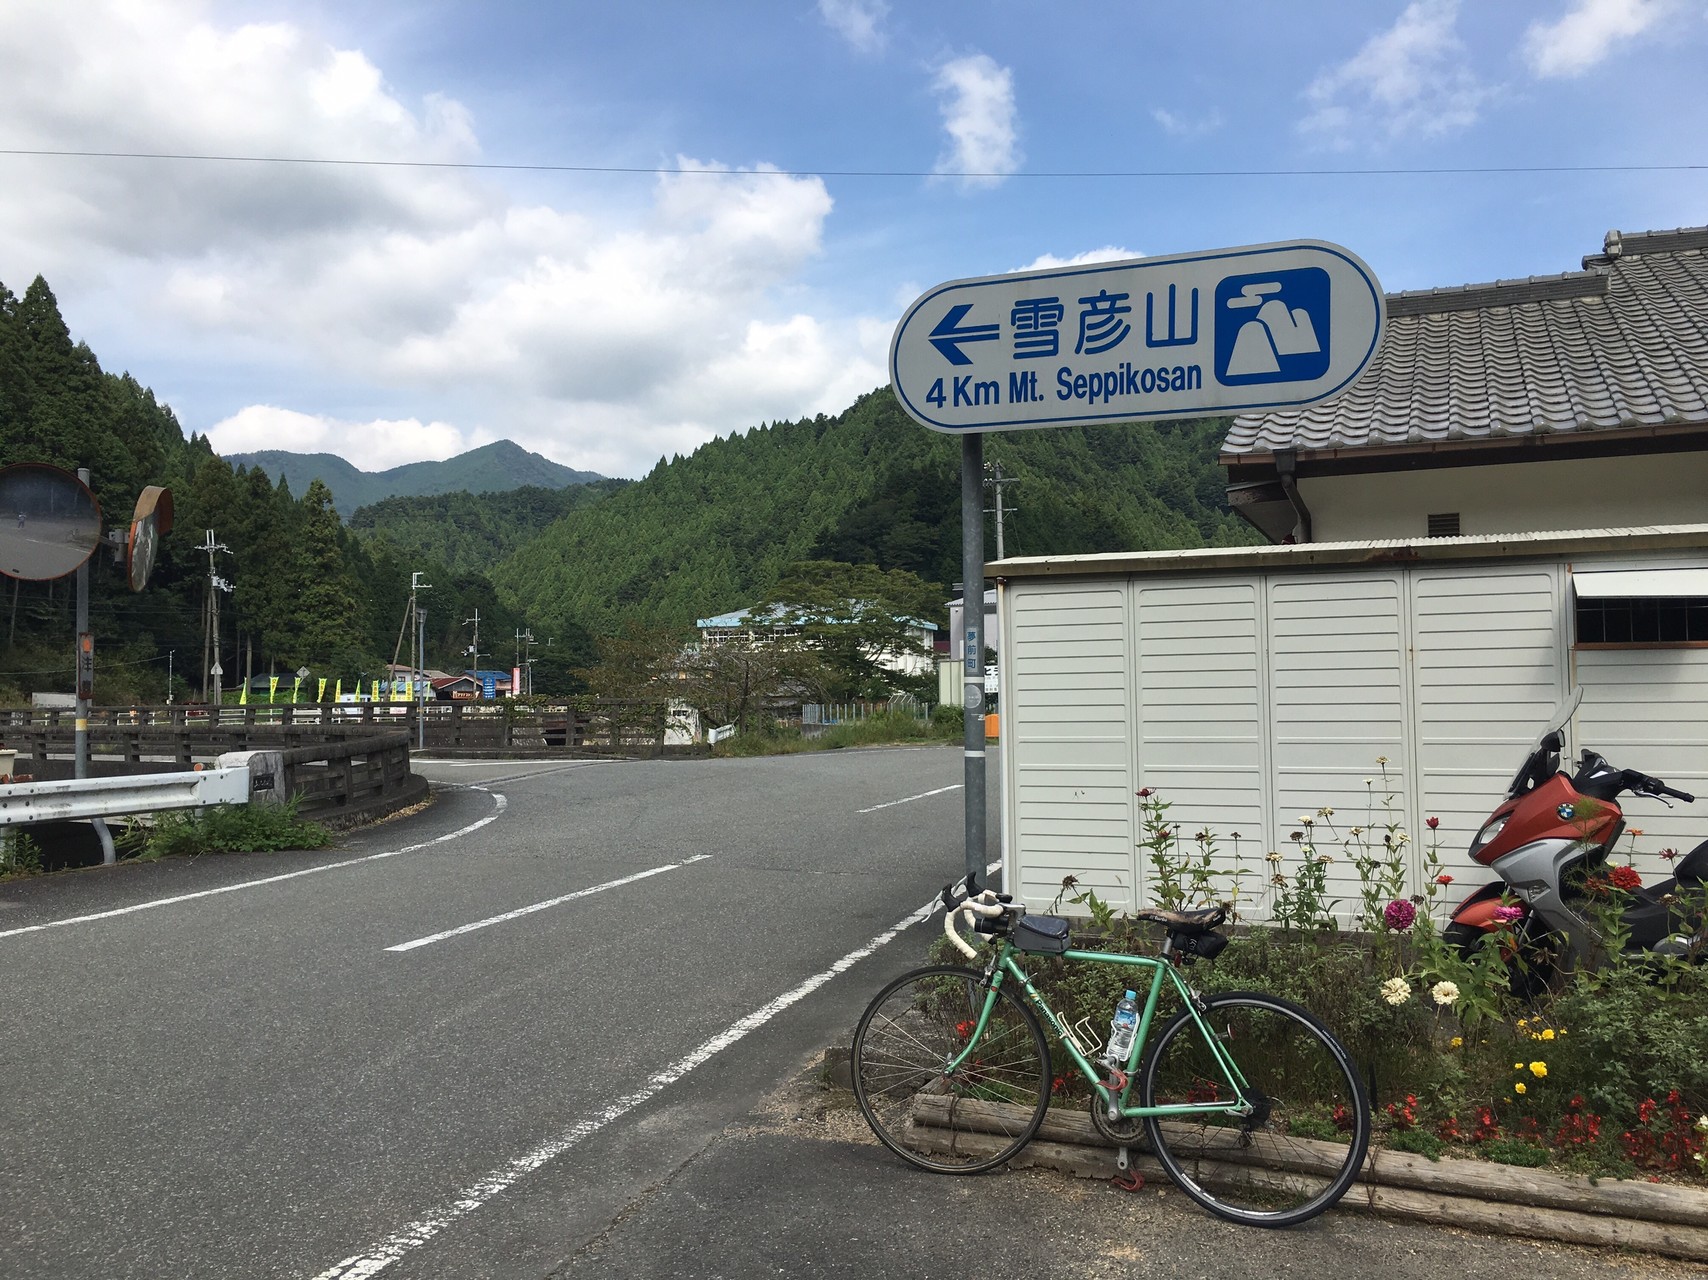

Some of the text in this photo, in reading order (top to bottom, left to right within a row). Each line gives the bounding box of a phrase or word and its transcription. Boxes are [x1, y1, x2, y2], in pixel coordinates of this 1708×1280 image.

[1011, 283, 1198, 359] 雪彦山
[926, 362, 1202, 408] 4 Km Mt. Seppikosan
[967, 631, 976, 669] 夢前町
[1036, 1000, 1064, 1037] Panasonic
